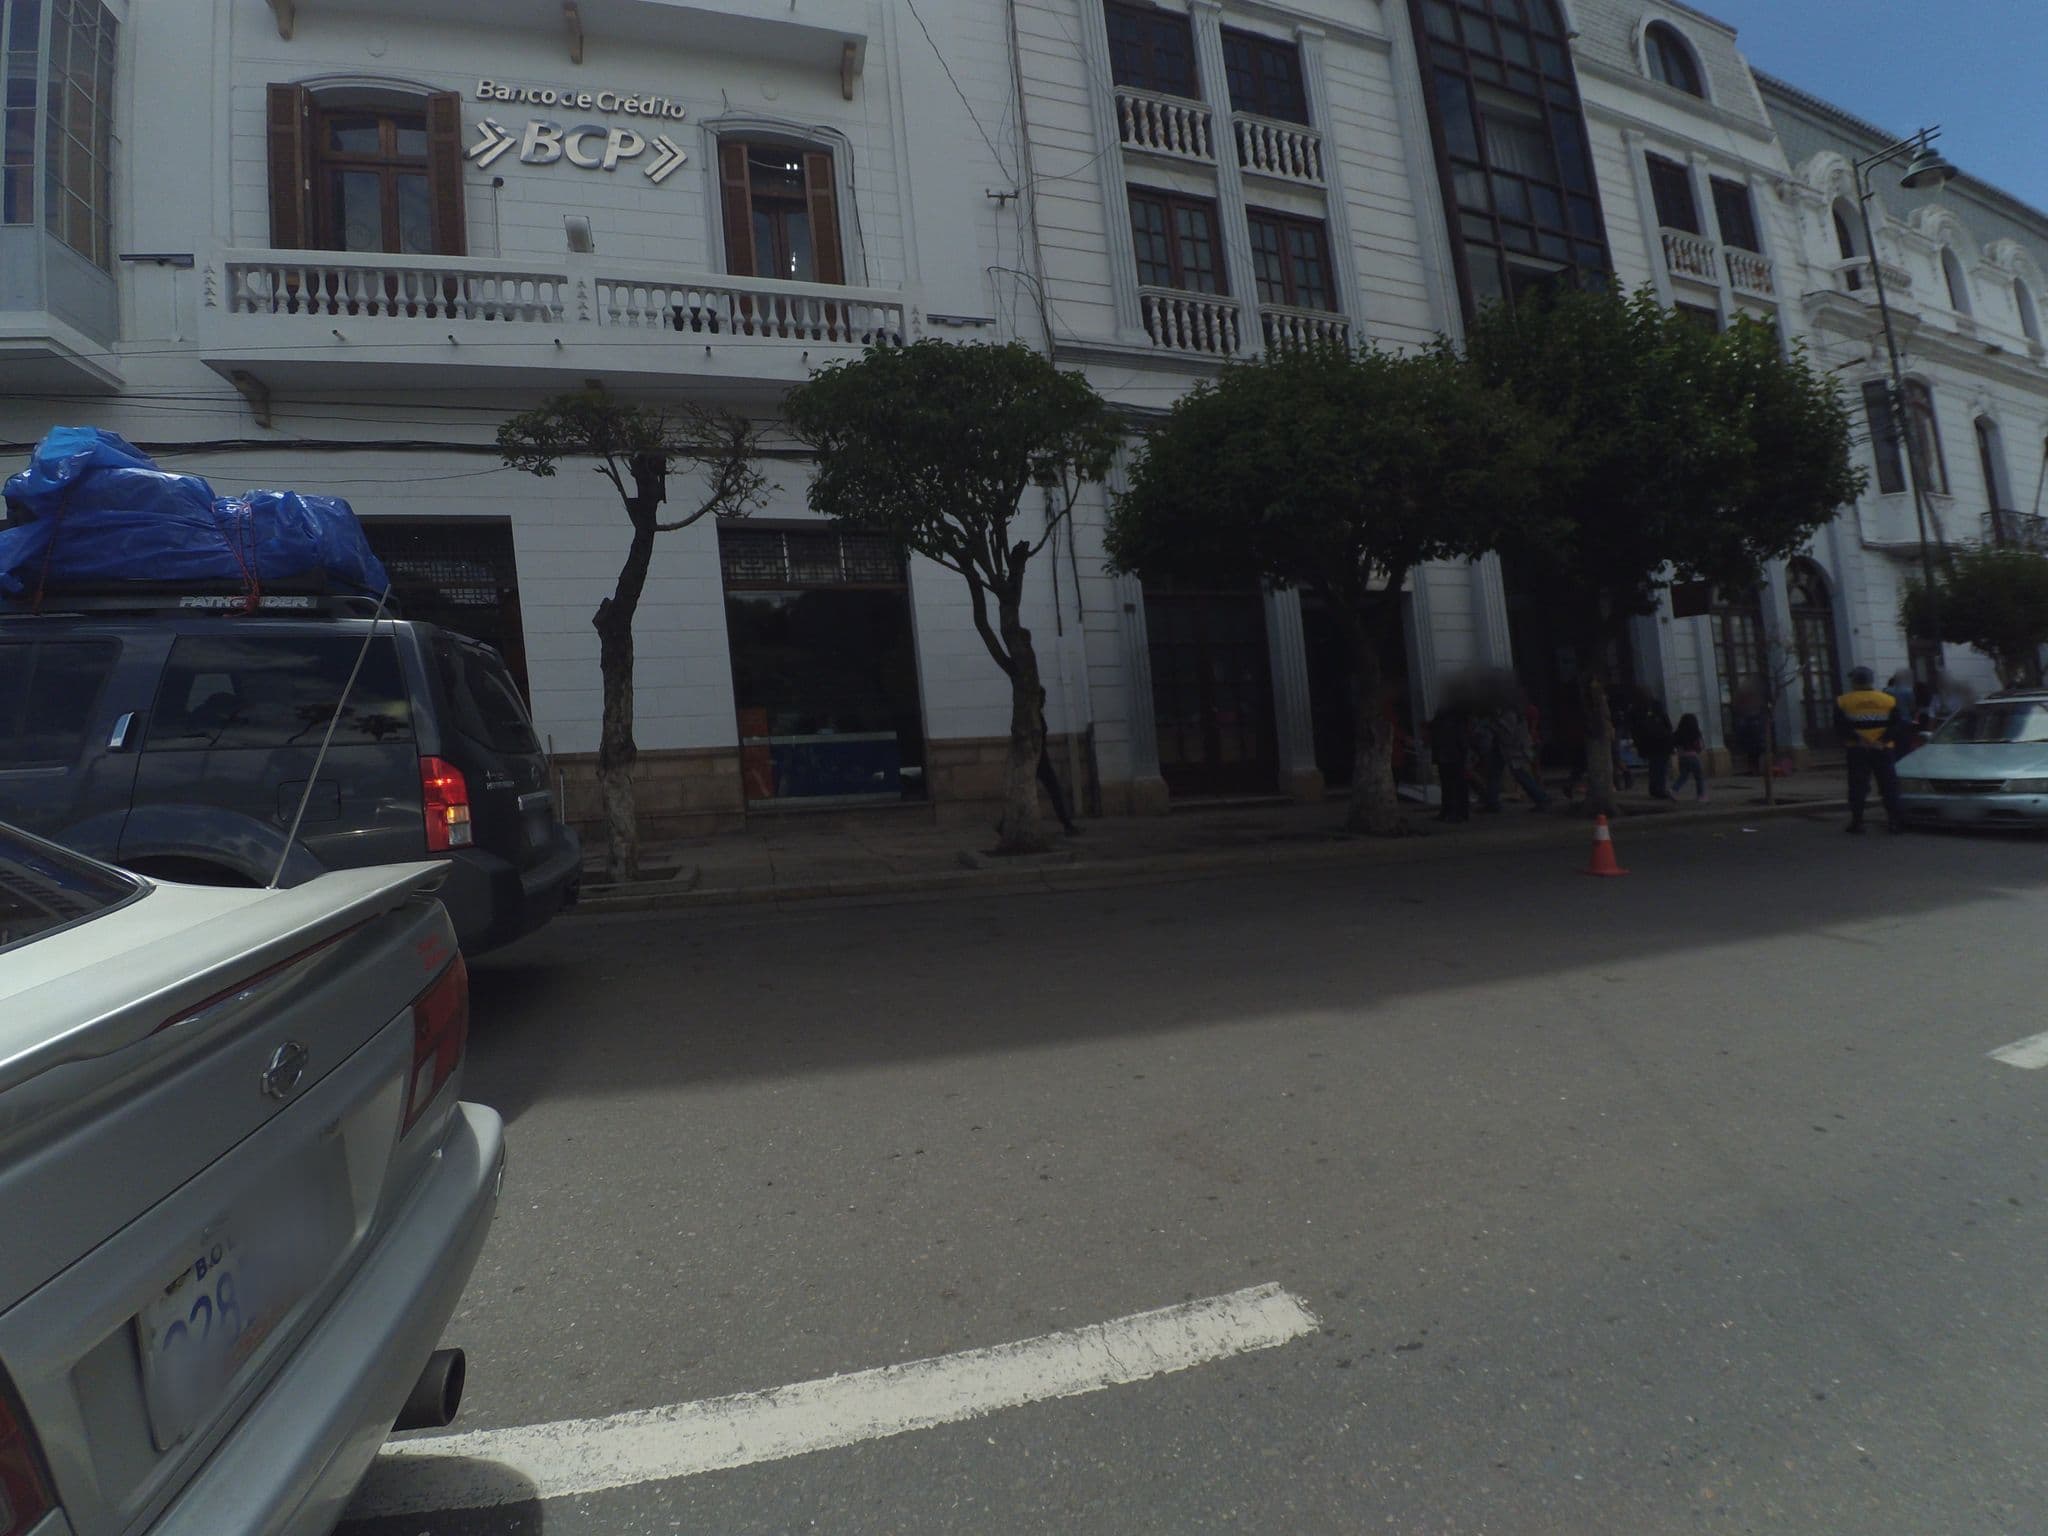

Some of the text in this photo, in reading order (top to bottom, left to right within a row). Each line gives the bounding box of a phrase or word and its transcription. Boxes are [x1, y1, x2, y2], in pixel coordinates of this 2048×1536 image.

[476, 79, 686, 119] Banco de Crédito
[519, 119, 646, 171] BCP
